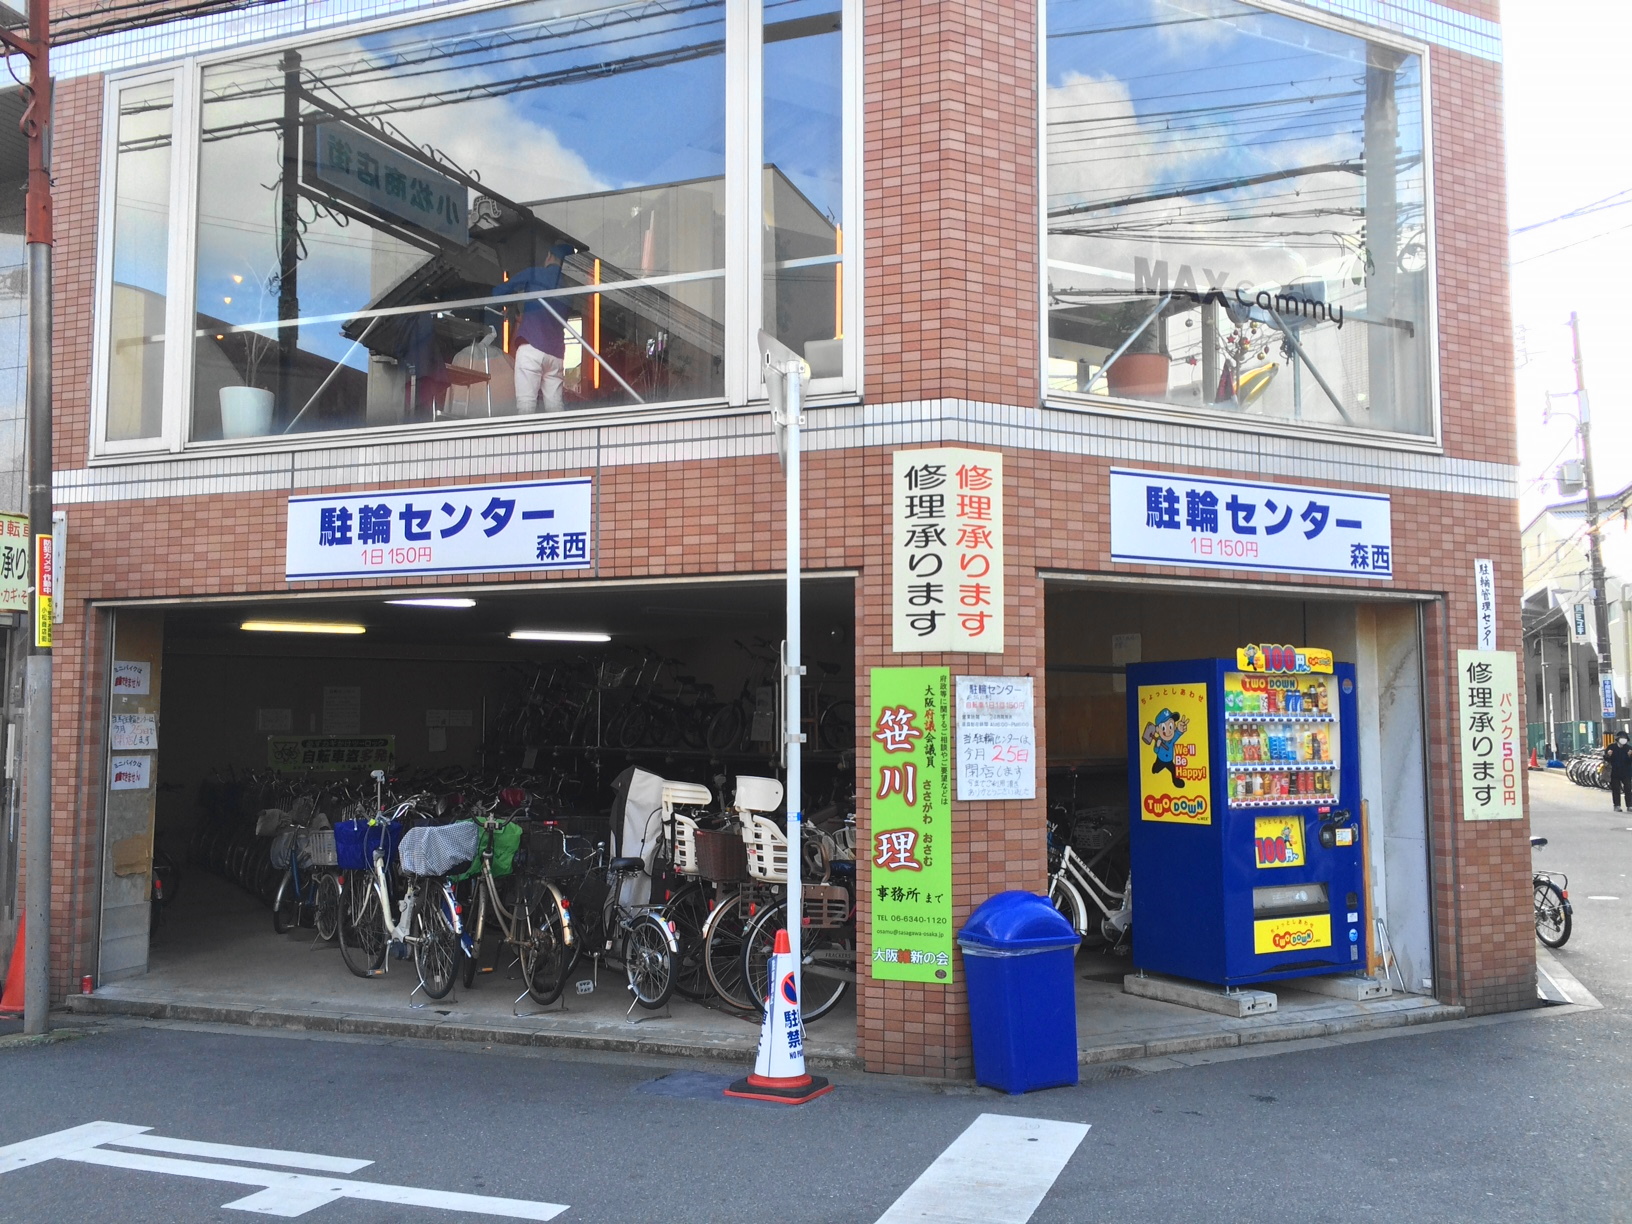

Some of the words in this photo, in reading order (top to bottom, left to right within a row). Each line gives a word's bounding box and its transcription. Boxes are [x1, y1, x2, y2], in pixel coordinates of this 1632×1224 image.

[1133, 256, 1231, 308] MAX
[318, 496, 554, 547] 駐輪センター
[1145, 485, 1362, 540] 駐輪センター
[43, 539, 51, 572] 防犯カメラ
[361, 546, 432, 565] 1日150円
[536, 531, 587, 561] 森西
[904, 464, 947, 637] 修理承ります
[955, 464, 993, 637] 修理承ります
[1190, 537, 1258, 558] 1日150円
[1350, 542, 1390, 571] 森西
[1479, 564, 1491, 646] 駐輪管理センター
[114, 665, 142, 674] ミニバイクは
[969, 684, 1022, 695] 駐輪センター
[1246, 679, 1265, 688] TWO
[1270, 680, 1295, 688] DOWN
[924, 684, 936, 768] 大阪府議会議員
[1467, 662, 1496, 807] 修理承ります
[963, 733, 1031, 745] 当駐輪センターは
[964, 747, 985, 761] 今月
[992, 745, 1029, 763] 25日
[1175, 744, 1195, 755] We'll
[1500, 693, 1516, 806] パンク500円
[114, 760, 142, 769] ミニバイクは
[1175, 756, 1187, 766] Be
[965, 763, 1023, 780] 閉店します
[1176, 767, 1206, 780] Happy!
[922, 779, 933, 825] ささがわ
[1148, 798, 1170, 814] TWO
[1173, 799, 1204, 814] DOWN
[922, 833, 933, 867] おさむ
[891, 915, 947, 924] 06-6340-1120
[877, 929, 944, 938] osamu@sasagawa-osaka.jp
[1275, 936, 1290, 946] TWO
[1292, 932, 1311, 943] DOWN
[873, 947, 949, 966] 大阪新の会
